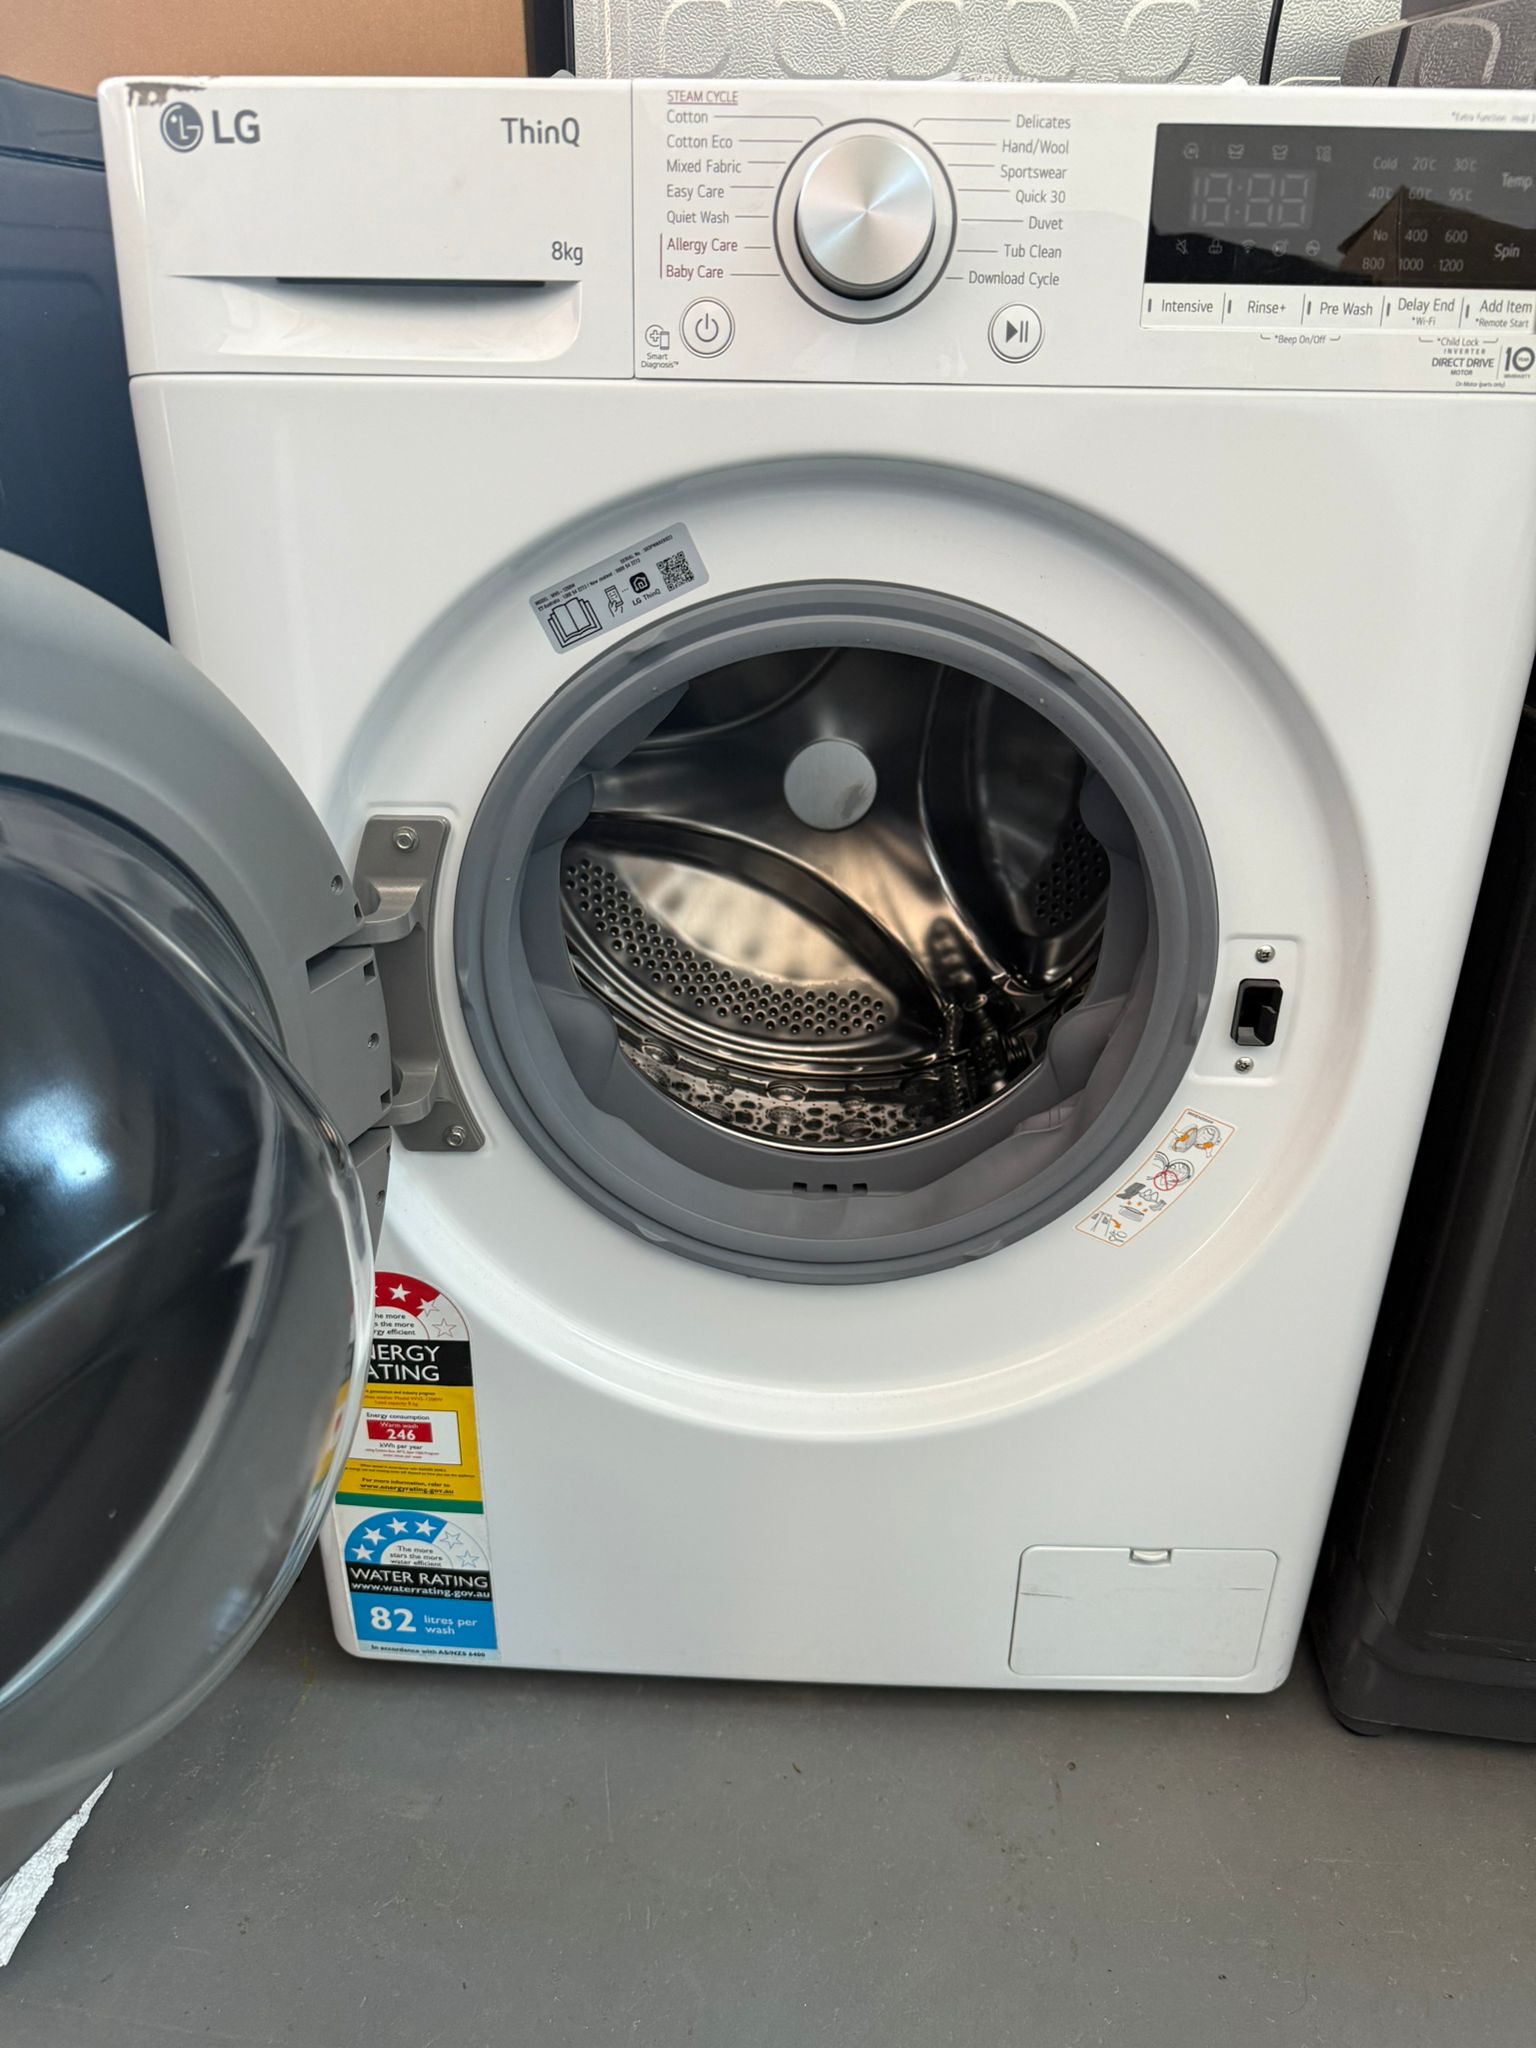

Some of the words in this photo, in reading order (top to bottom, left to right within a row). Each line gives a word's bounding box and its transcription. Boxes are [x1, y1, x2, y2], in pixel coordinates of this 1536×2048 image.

[667, 90, 703, 104] STEAM
[706, 91, 739, 104] CYCLE
[666, 109, 709, 124] Cotton
[1016, 113, 1072, 130] Delicates
[212, 109, 260, 144] LG
[500, 117, 581, 147] ThinQ
[666, 134, 708, 149] Cotton
[711, 134, 734, 149] Eco
[1001, 138, 1070, 155] Hand/Wool
[666, 159, 702, 173] Mixed
[706, 159, 742, 173] Fabric
[1373, 156, 1399, 171] Cold
[1000, 163, 1067, 181] Sportswear
[666, 184, 694, 201] Easy
[697, 184, 725, 198] Care
[1015, 189, 1047, 205] Quick
[1050, 190, 1066, 204] 30
[666, 210, 696, 224] Quiet
[700, 210, 729, 223] Wash
[1028, 215, 1063, 230] Duvet
[1373, 229, 1389, 241] No
[1404, 229, 1428, 242] 400
[1444, 230, 1468, 243] 600
[551, 241, 584, 265] 8kg
[667, 237, 708, 255] Allergy
[711, 238, 738, 252] Care
[1004, 243, 1026, 258] Tub
[1029, 243, 1062, 259] Clean
[1494, 243, 1520, 261] Spin
[1362, 257, 1385, 270] 800
[1399, 258, 1425, 271] 1000
[1439, 259, 1465, 272] 1200
[666, 264, 694, 281] Baby
[697, 265, 724, 278] Care
[968, 270, 1025, 285] Download
[1028, 271, 1060, 289] Cycle
[1161, 299, 1214, 314] Intensive
[1247, 300, 1287, 315] Rinse+
[1320, 301, 1339, 315] Pre
[1343, 302, 1373, 316] Wash
[1397, 297, 1430, 315] Delay
[1433, 298, 1455, 312] End
[1480, 300, 1504, 313] Add
[1506, 300, 1533, 314] Item
[1509, 319, 1529, 329] Start
[1299, 334, 1327, 345] On/Off
[1462, 338, 1479, 347] Lock
[647, 352, 668, 361] Smart
[1432, 357, 1466, 367] DIRECT
[1466, 358, 1495, 368] DRIVE
[631, 597, 642, 607] LG
[642, 588, 662, 601] ThinQ
[368, 1364, 440, 1382] ATING
[386, 1428, 416, 1441] 246
[351, 1567, 415, 1584] WATER
[419, 1572, 488, 1588] RATING
[351, 1582, 490, 1598] www.waterrating.gov.au
[370, 1606, 417, 1633] 82
[424, 1614, 454, 1625] litres
[457, 1618, 478, 1628] per
[425, 1626, 455, 1635] wash
